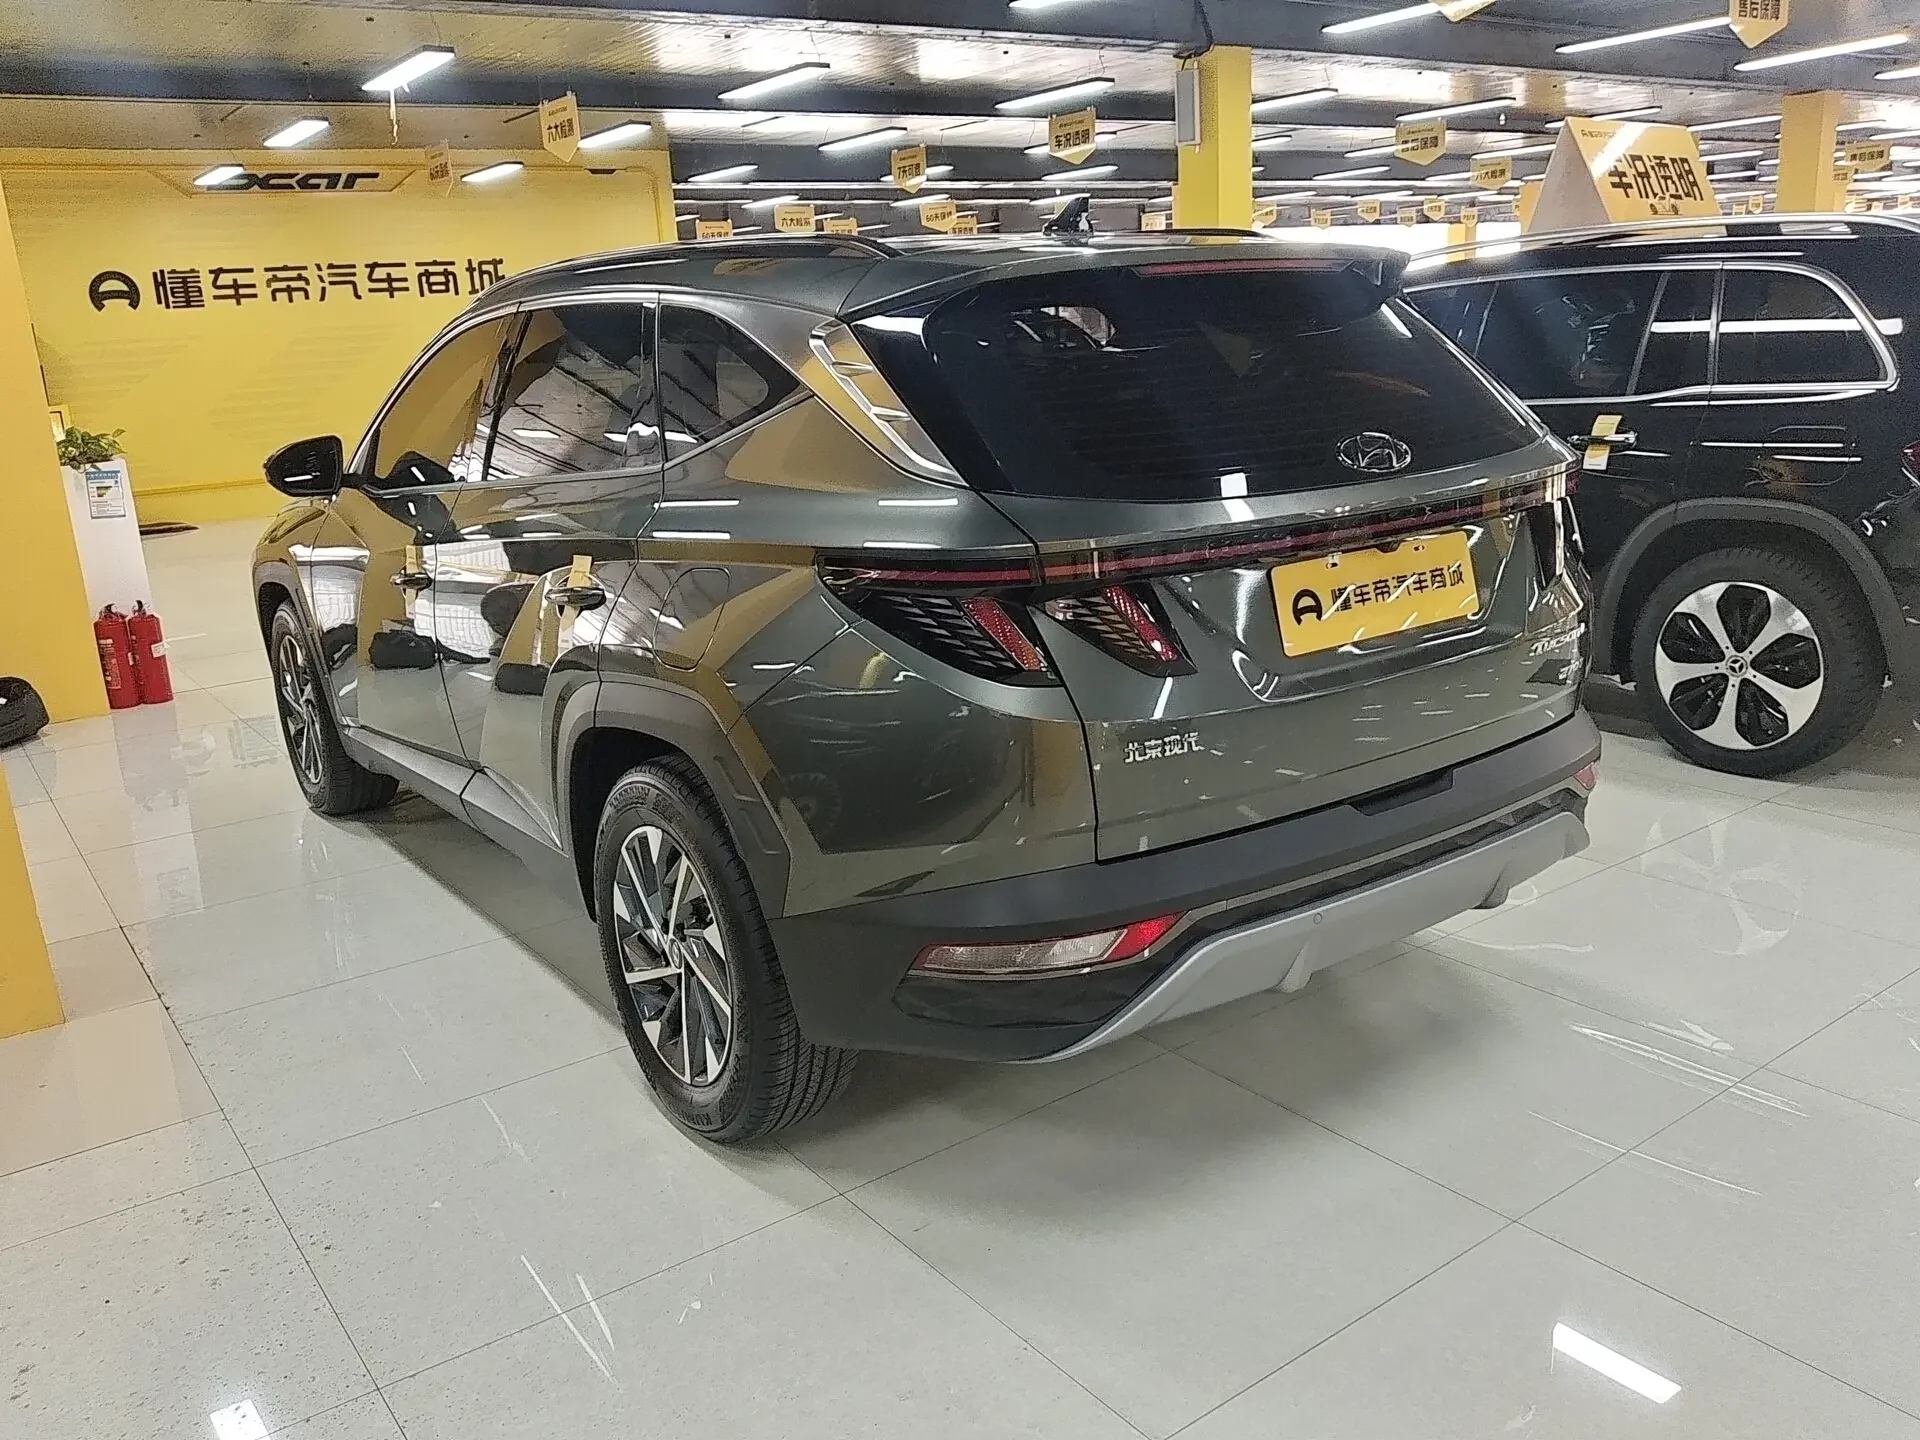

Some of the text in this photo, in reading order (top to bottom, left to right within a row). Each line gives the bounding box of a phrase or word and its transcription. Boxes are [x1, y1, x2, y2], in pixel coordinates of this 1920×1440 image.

[547, 117, 575, 144] 六大检测
[1054, 128, 1090, 149] 车况透明
[1608, 153, 1704, 201] 车况透明
[152, 257, 506, 310] 懂车帝汽车商城
[1330, 561, 1465, 613] 懂车帝汽车商城
[1124, 731, 1206, 764] 北京现代
